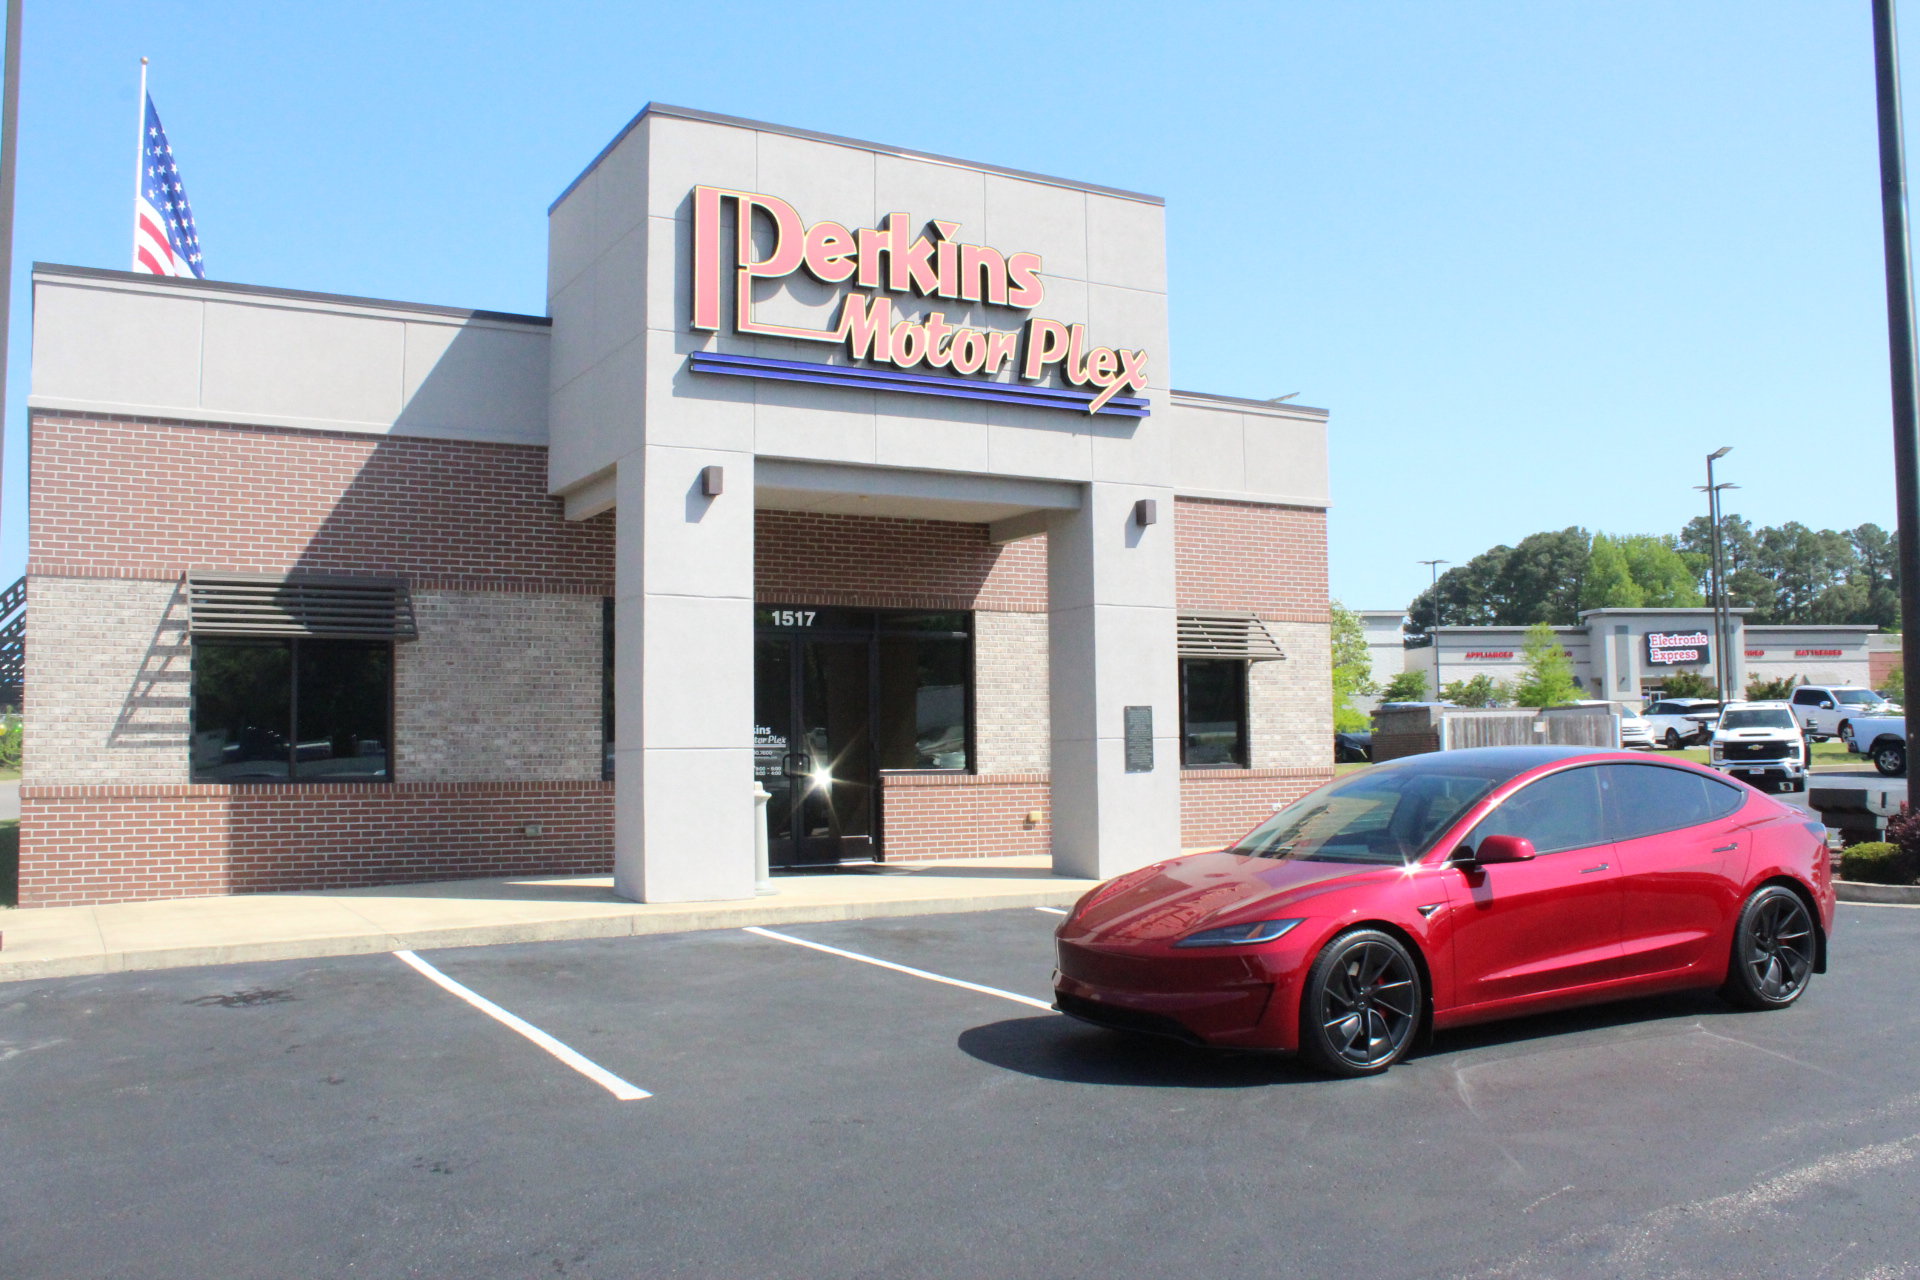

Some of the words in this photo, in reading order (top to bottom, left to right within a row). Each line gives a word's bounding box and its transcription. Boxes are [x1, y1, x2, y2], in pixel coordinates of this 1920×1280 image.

[692, 184, 1045, 331] Perkins
[842, 293, 1018, 374] Motor
[1022, 318, 1149, 414] Plex
[771, 610, 816, 627] 1517
[1649, 631, 1708, 647] Electronic
[1650, 648, 1698, 664] Express
[768, 735, 786, 744] Plex
